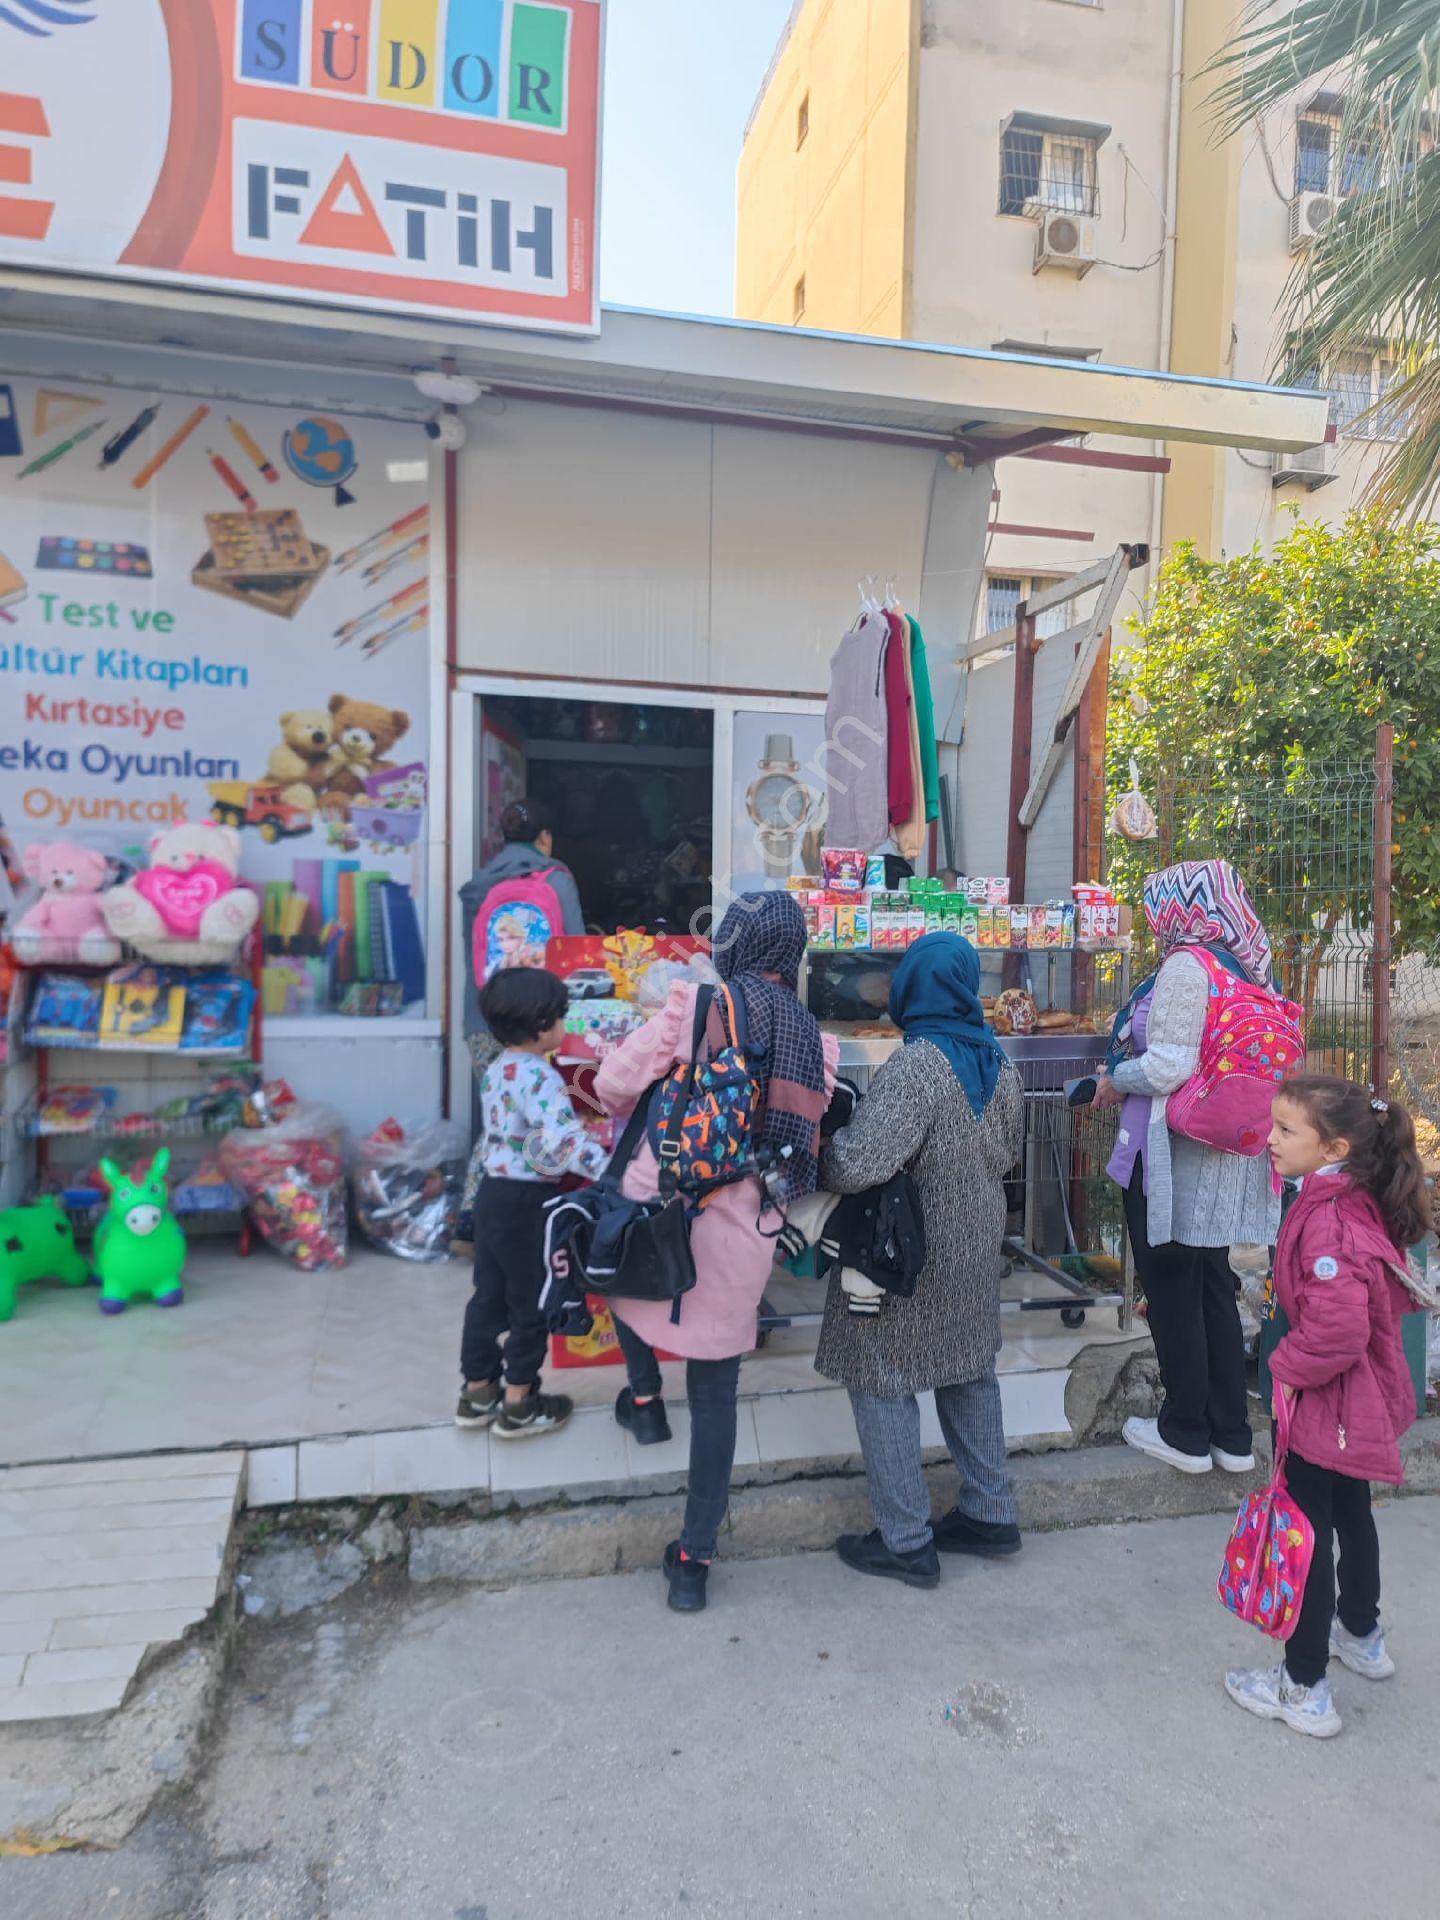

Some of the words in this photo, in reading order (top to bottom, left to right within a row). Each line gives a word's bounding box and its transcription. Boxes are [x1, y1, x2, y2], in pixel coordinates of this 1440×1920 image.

[254, 19, 553, 115] SÜDOR
[38, 594, 118, 629] Test
[131, 607, 176, 633] ve
[97, 649, 249, 690] Kitapları
[25, 692, 186, 737] Kırtasiye
[0, 739, 68, 772] eka
[81, 744, 239, 782] Oyunları
[23, 787, 188, 827] Oyuncak
